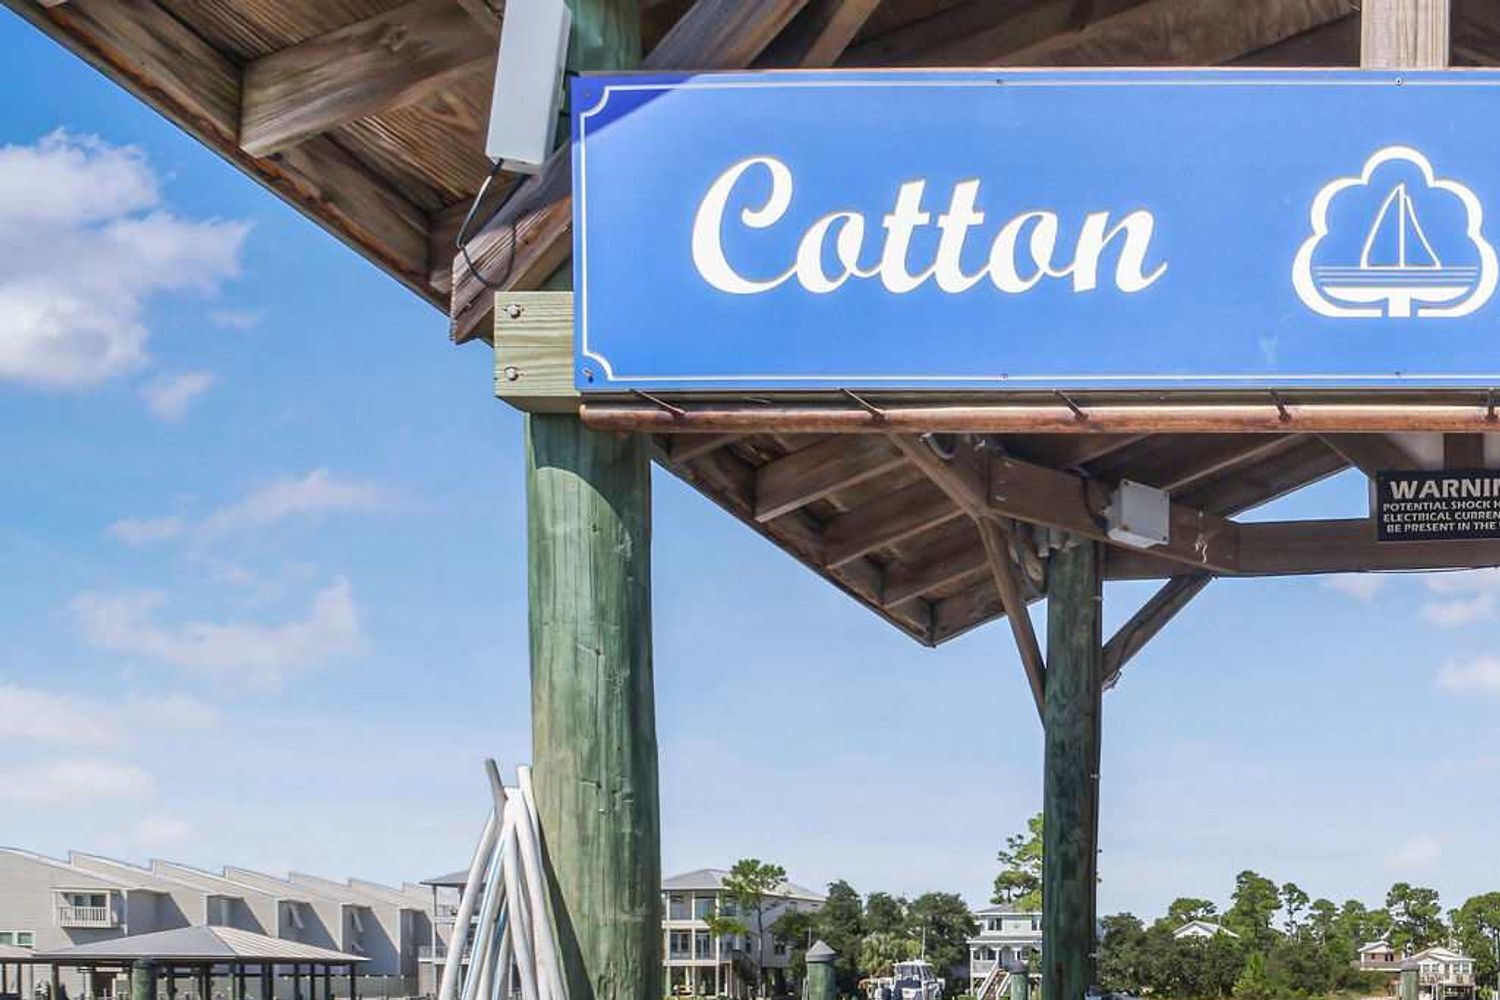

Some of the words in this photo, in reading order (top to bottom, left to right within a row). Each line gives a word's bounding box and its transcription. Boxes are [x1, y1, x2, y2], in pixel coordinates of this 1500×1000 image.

[690, 153, 1169, 295] Cotton
[1383, 501, 1449, 513] POTENTIAL
[1451, 500, 1491, 510] SHOCK
[1383, 511, 1452, 523] ELECTRICAL
[1386, 523, 1402, 533] BE
[1404, 522, 1455, 533] PRESENT
[1457, 522, 1471, 531] IN
[1472, 521, 1497, 531] THE
